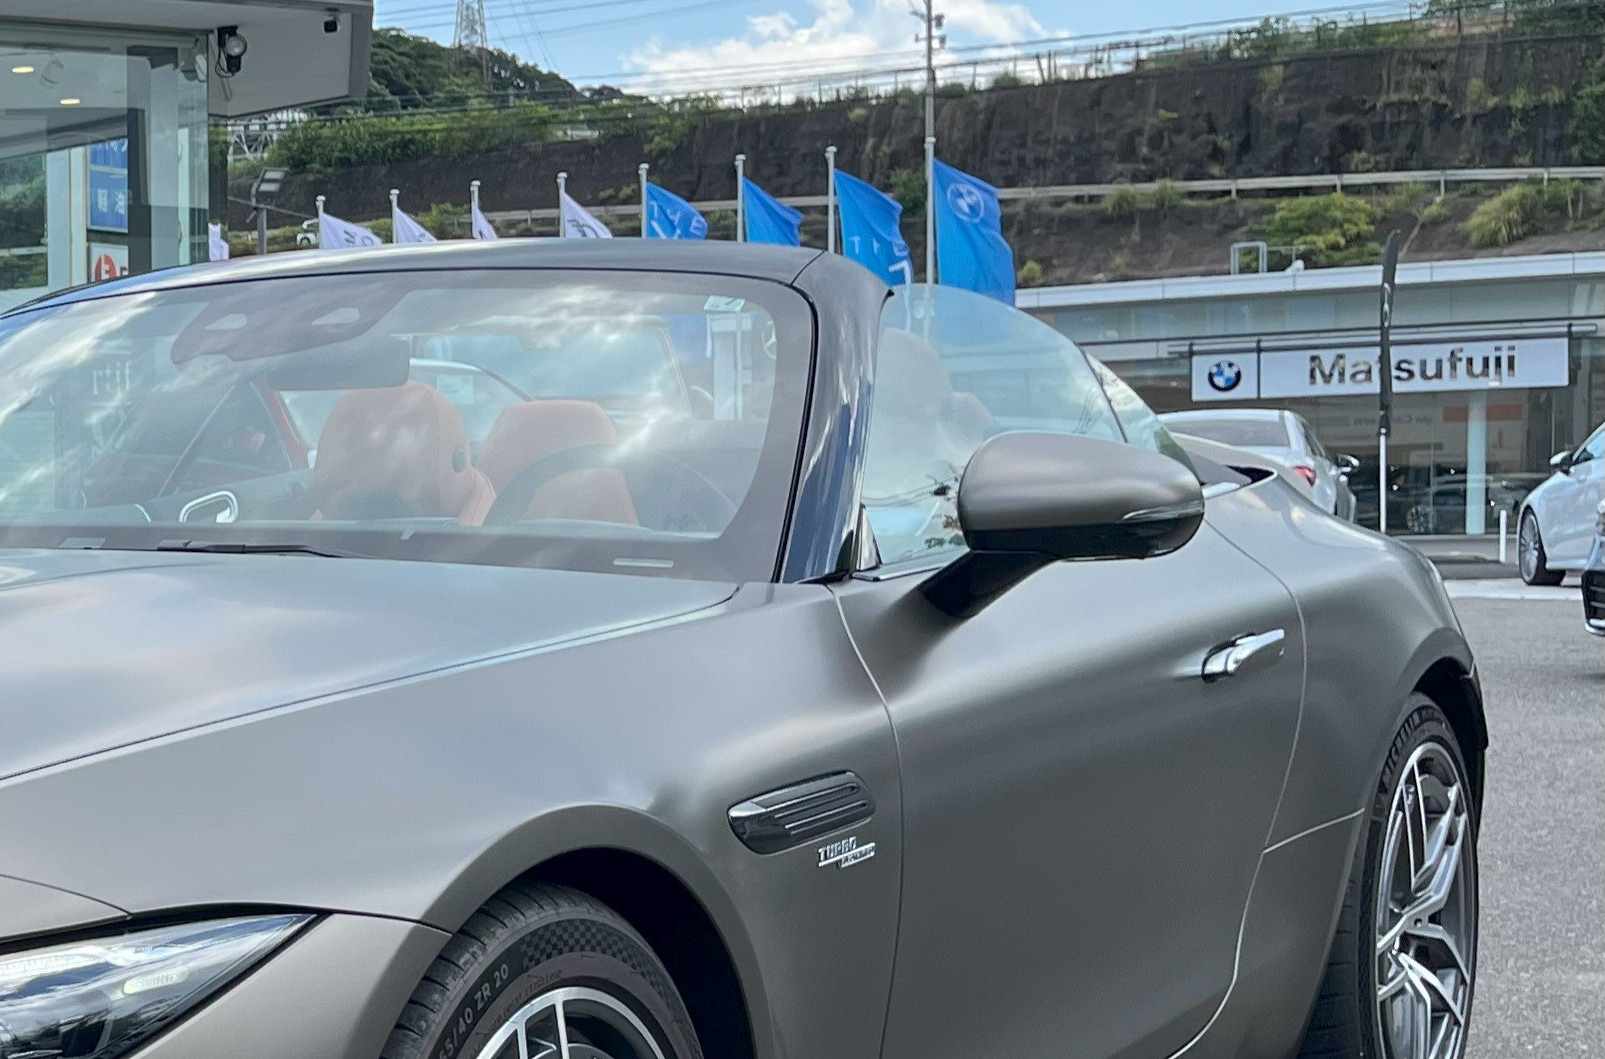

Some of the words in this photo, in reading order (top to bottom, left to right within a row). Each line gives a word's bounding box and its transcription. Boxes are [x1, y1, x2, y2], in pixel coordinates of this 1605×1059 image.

[1308, 345, 1516, 386] Masufuji
[473, 983, 493, 1012] ZR
[494, 962, 510, 987] 20
